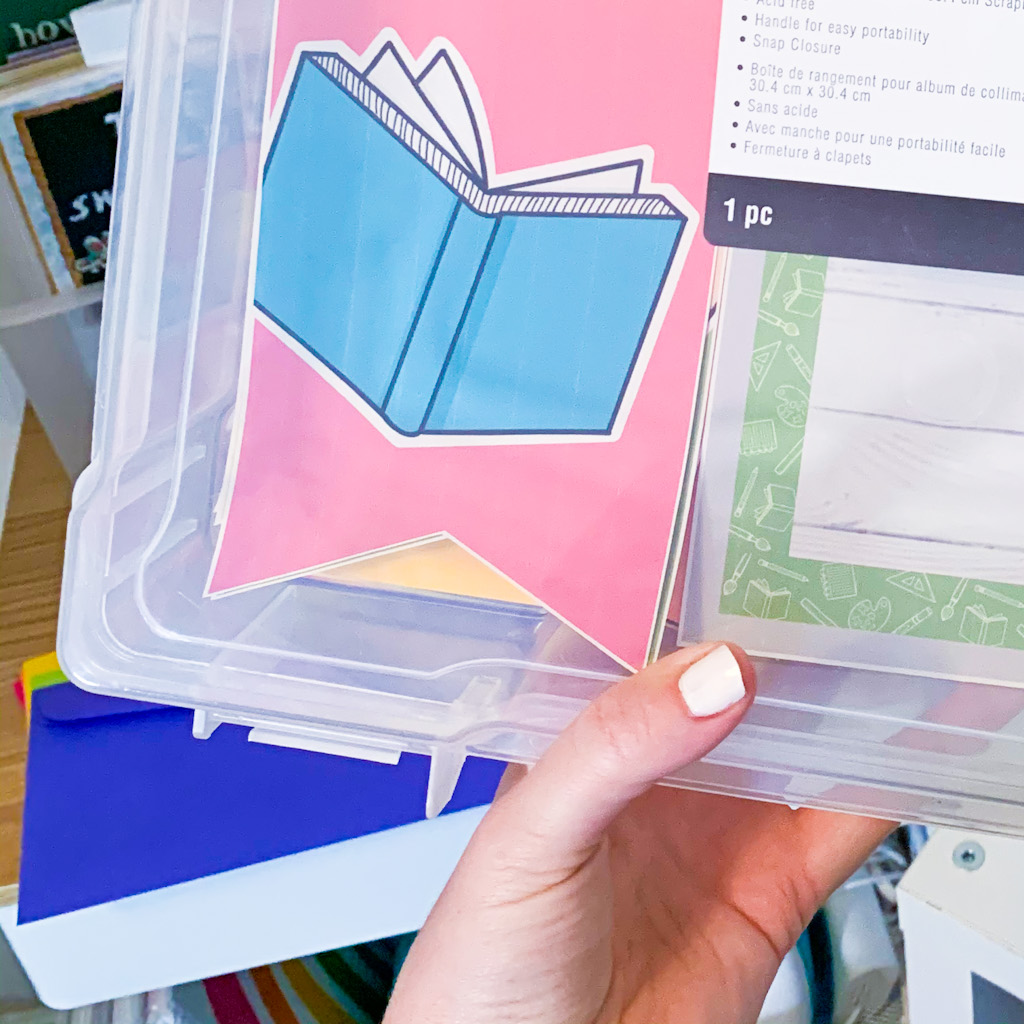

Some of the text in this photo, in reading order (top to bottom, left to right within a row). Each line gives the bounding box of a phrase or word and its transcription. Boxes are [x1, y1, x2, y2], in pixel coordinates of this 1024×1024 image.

[754, 13, 930, 45] Handle for easy portability
[753, 34, 841, 55] Snap Closure
[749, 78, 871, 102] 30.4 cm x 30.4 cm
[751, 62, 783, 78] Boîte
[789, 66, 804, 80] de
[809, 70, 877, 87] rangement
[881, 77, 911, 91] pour
[916, 80, 955, 95] album
[961, 83, 975, 97] de
[747, 99, 818, 118] Sans acide
[744, 140, 872, 166] Fermeture à clapets
[745, 120, 1006, 158] Avec manche pour une portabilité facile
[723, 197, 773, 229] 1 pc
